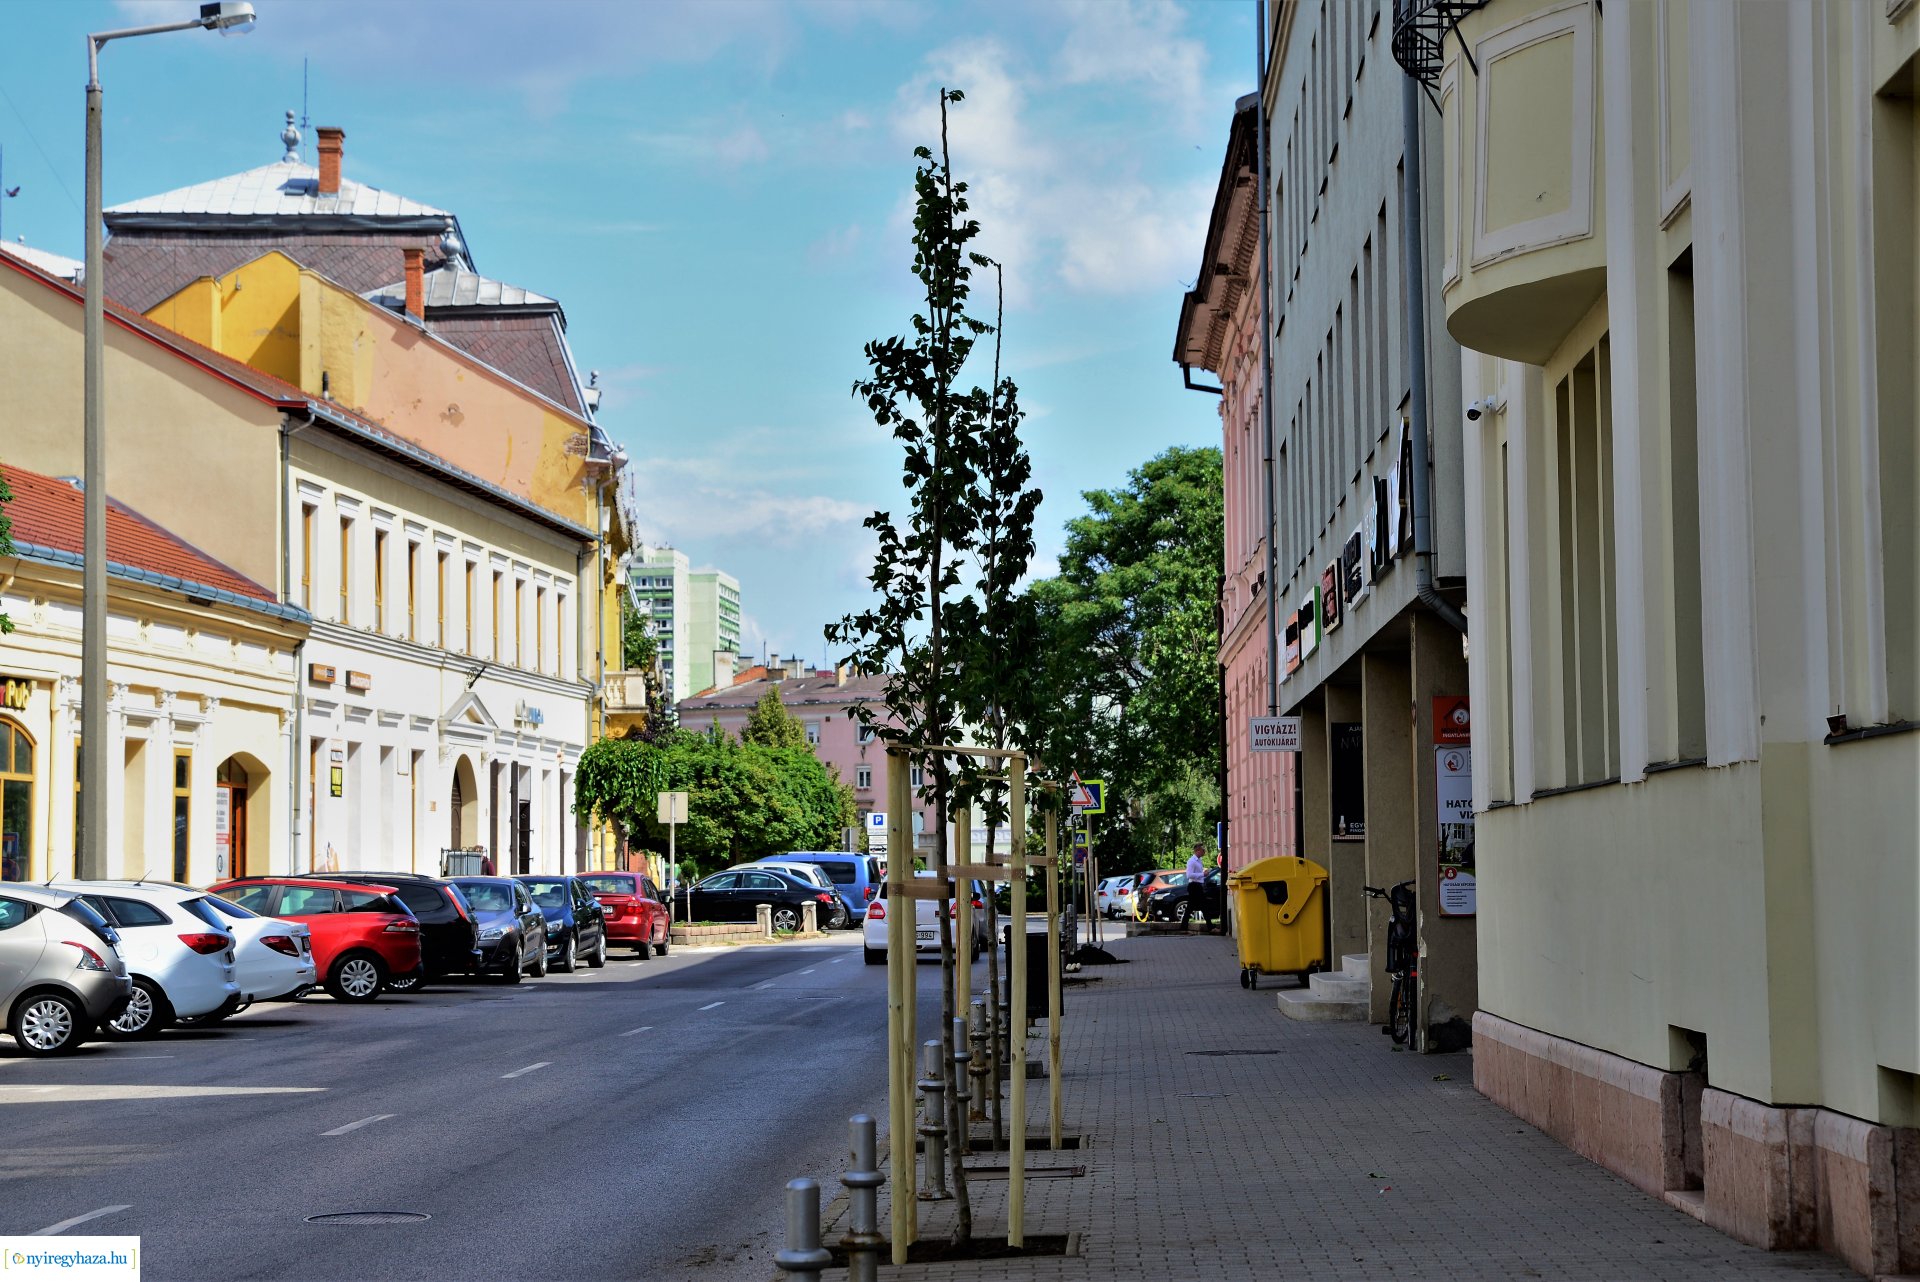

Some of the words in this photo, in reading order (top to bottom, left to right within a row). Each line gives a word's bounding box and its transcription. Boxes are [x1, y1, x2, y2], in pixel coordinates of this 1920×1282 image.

[5, 679, 29, 709] Pub
[1254, 721, 1297, 735] VIGYÁZZ!
[1254, 736, 1297, 746] AUTÓKIJÁRAT
[875, 816, 882, 824] P
